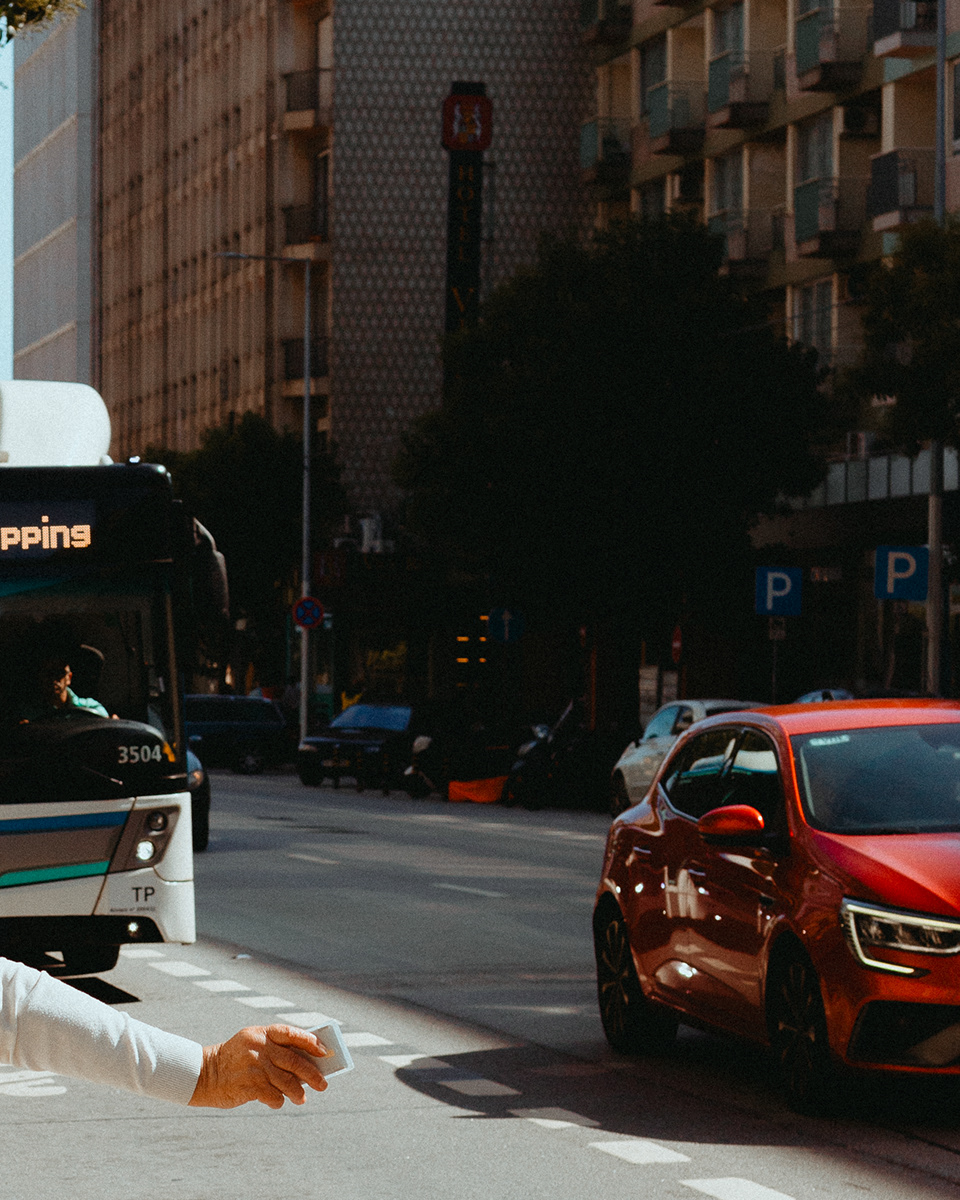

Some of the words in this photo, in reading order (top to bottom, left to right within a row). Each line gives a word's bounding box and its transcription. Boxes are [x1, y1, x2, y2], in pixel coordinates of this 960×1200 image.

[456, 165, 475, 262] HOTEL
[765, 571, 793, 611] P
[886, 551, 917, 594] P
[117, 744, 162, 764] 3504
[131, 887, 156, 902] TP
